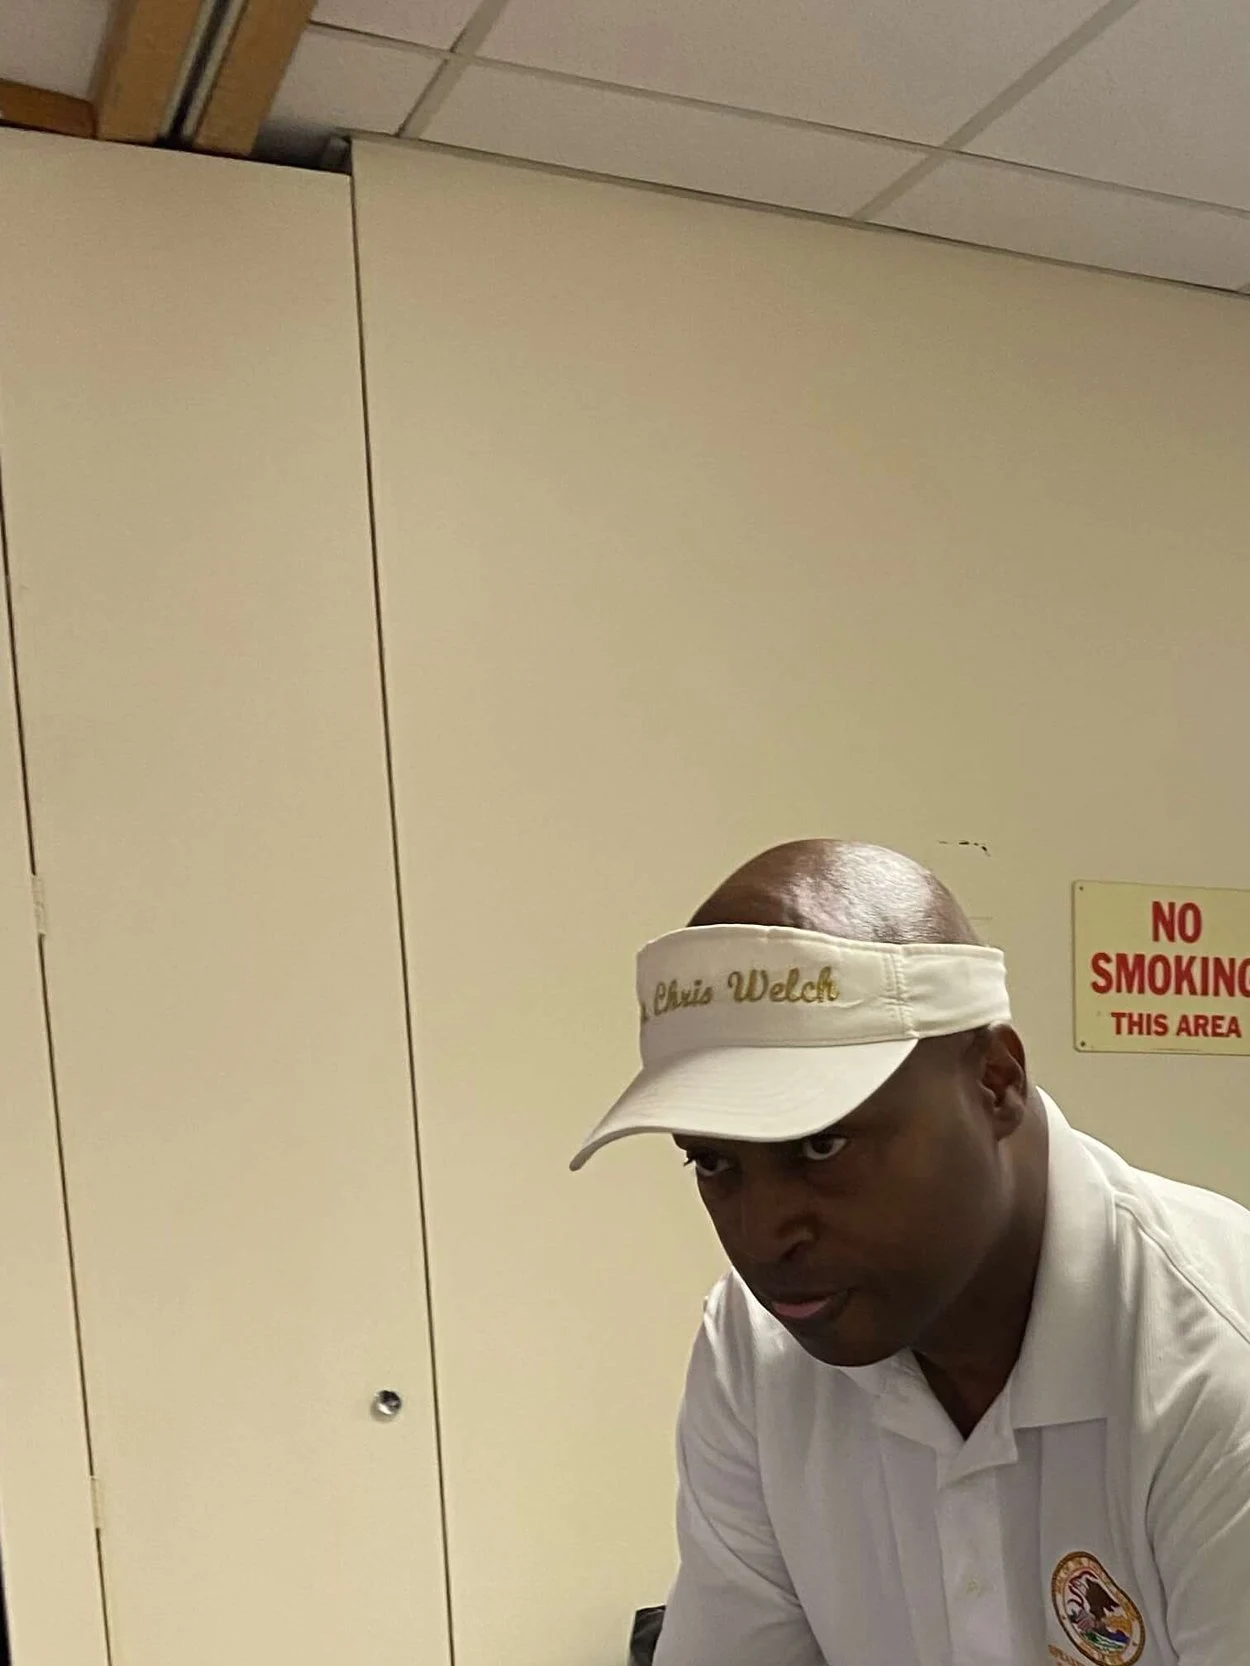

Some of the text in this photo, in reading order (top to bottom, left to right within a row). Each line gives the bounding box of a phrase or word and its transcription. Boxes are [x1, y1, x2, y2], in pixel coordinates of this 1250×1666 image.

[1152, 900, 1202, 944] NO
[654, 979, 713, 1016] Chris
[727, 966, 839, 1004] Welch
[1111, 1011, 1243, 1038] THIS AREA
